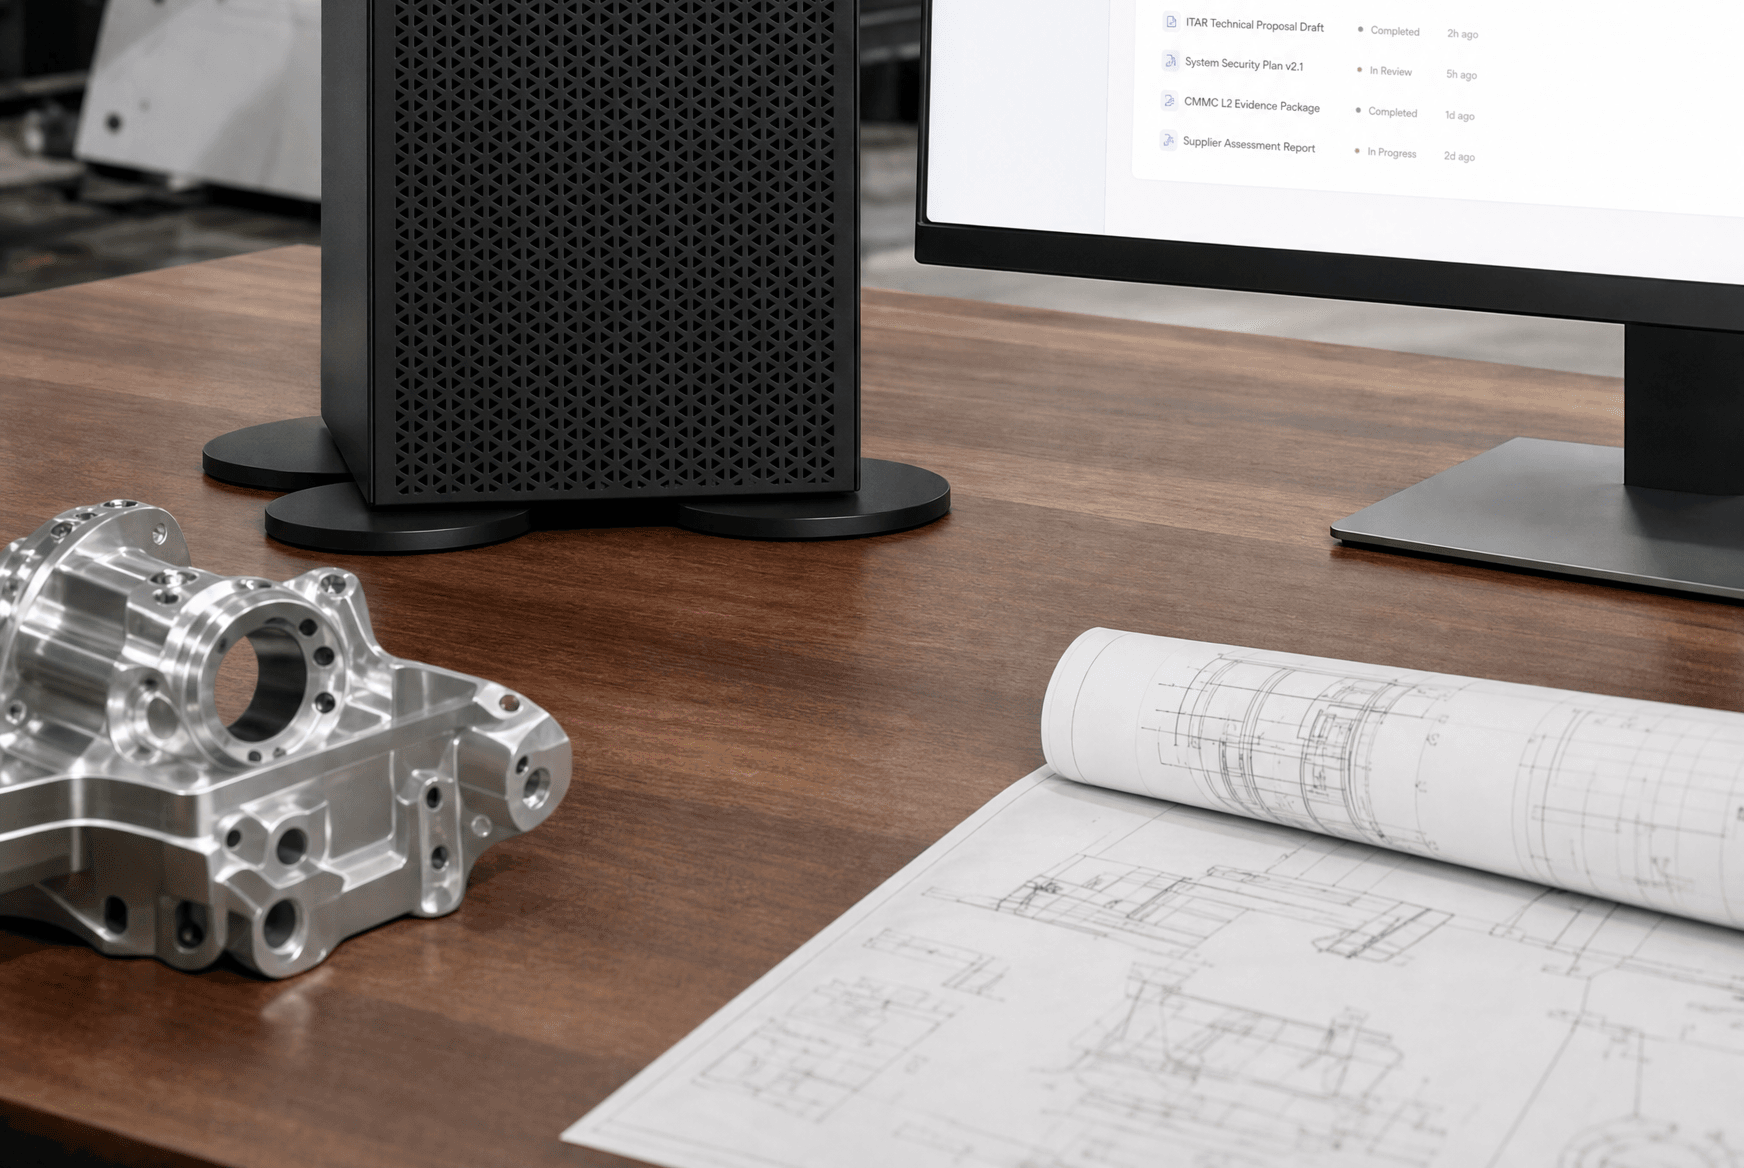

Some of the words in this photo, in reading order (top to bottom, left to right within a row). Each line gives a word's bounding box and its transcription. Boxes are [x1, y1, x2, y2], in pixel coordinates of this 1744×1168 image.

[1186, 17, 1209, 28] ITAR
[1209, 17, 1255, 30] Technical
[1256, 19, 1298, 33] Proposal
[1299, 21, 1325, 33] Draft
[1370, 24, 1421, 38] Completed
[1447, 28, 1460, 39] 2h
[1460, 31, 1480, 42] ago
[1185, 56, 1220, 69] System
[1221, 57, 1261, 72] Security
[1262, 59, 1284, 71] Plan
[1285, 61, 1304, 72] v2.1
[1369, 65, 1379, 75] In
[1380, 65, 1413, 77] Review
[1446, 68, 1459, 79] 5h
[1459, 71, 1478, 83] ago
[1184, 96, 1219, 108] CMMC
[1221, 98, 1233, 109] L2
[1234, 98, 1278, 111] Evidence
[1280, 100, 1321, 116] Package
[1368, 105, 1418, 119] Completed
[1444, 110, 1456, 120] 1d
[1457, 112, 1476, 123] ago
[1183, 135, 1223, 149] Supplier
[1223, 138, 1281, 152] Assessment
[1283, 141, 1316, 155] Report
[1367, 146, 1377, 156] In
[1378, 147, 1417, 160] Progress
[1443, 150, 1457, 161] 2d
[1457, 153, 1476, 164] ago
